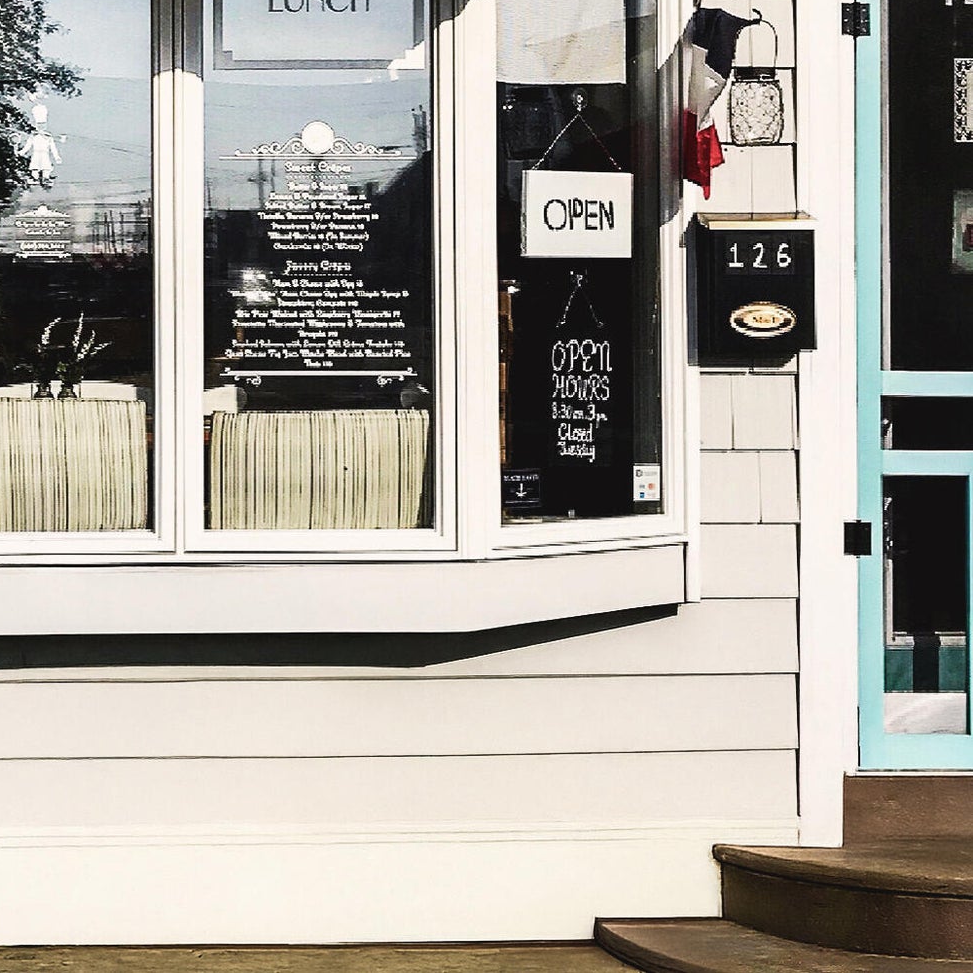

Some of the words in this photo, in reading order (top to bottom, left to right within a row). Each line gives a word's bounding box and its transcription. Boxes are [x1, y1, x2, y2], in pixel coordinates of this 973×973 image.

[543, 198, 615, 230] OPEN
[729, 243, 791, 268] 126
[551, 339, 613, 373] OPEN
[551, 373, 610, 401] HOURS
[557, 422, 594, 442] Closed
